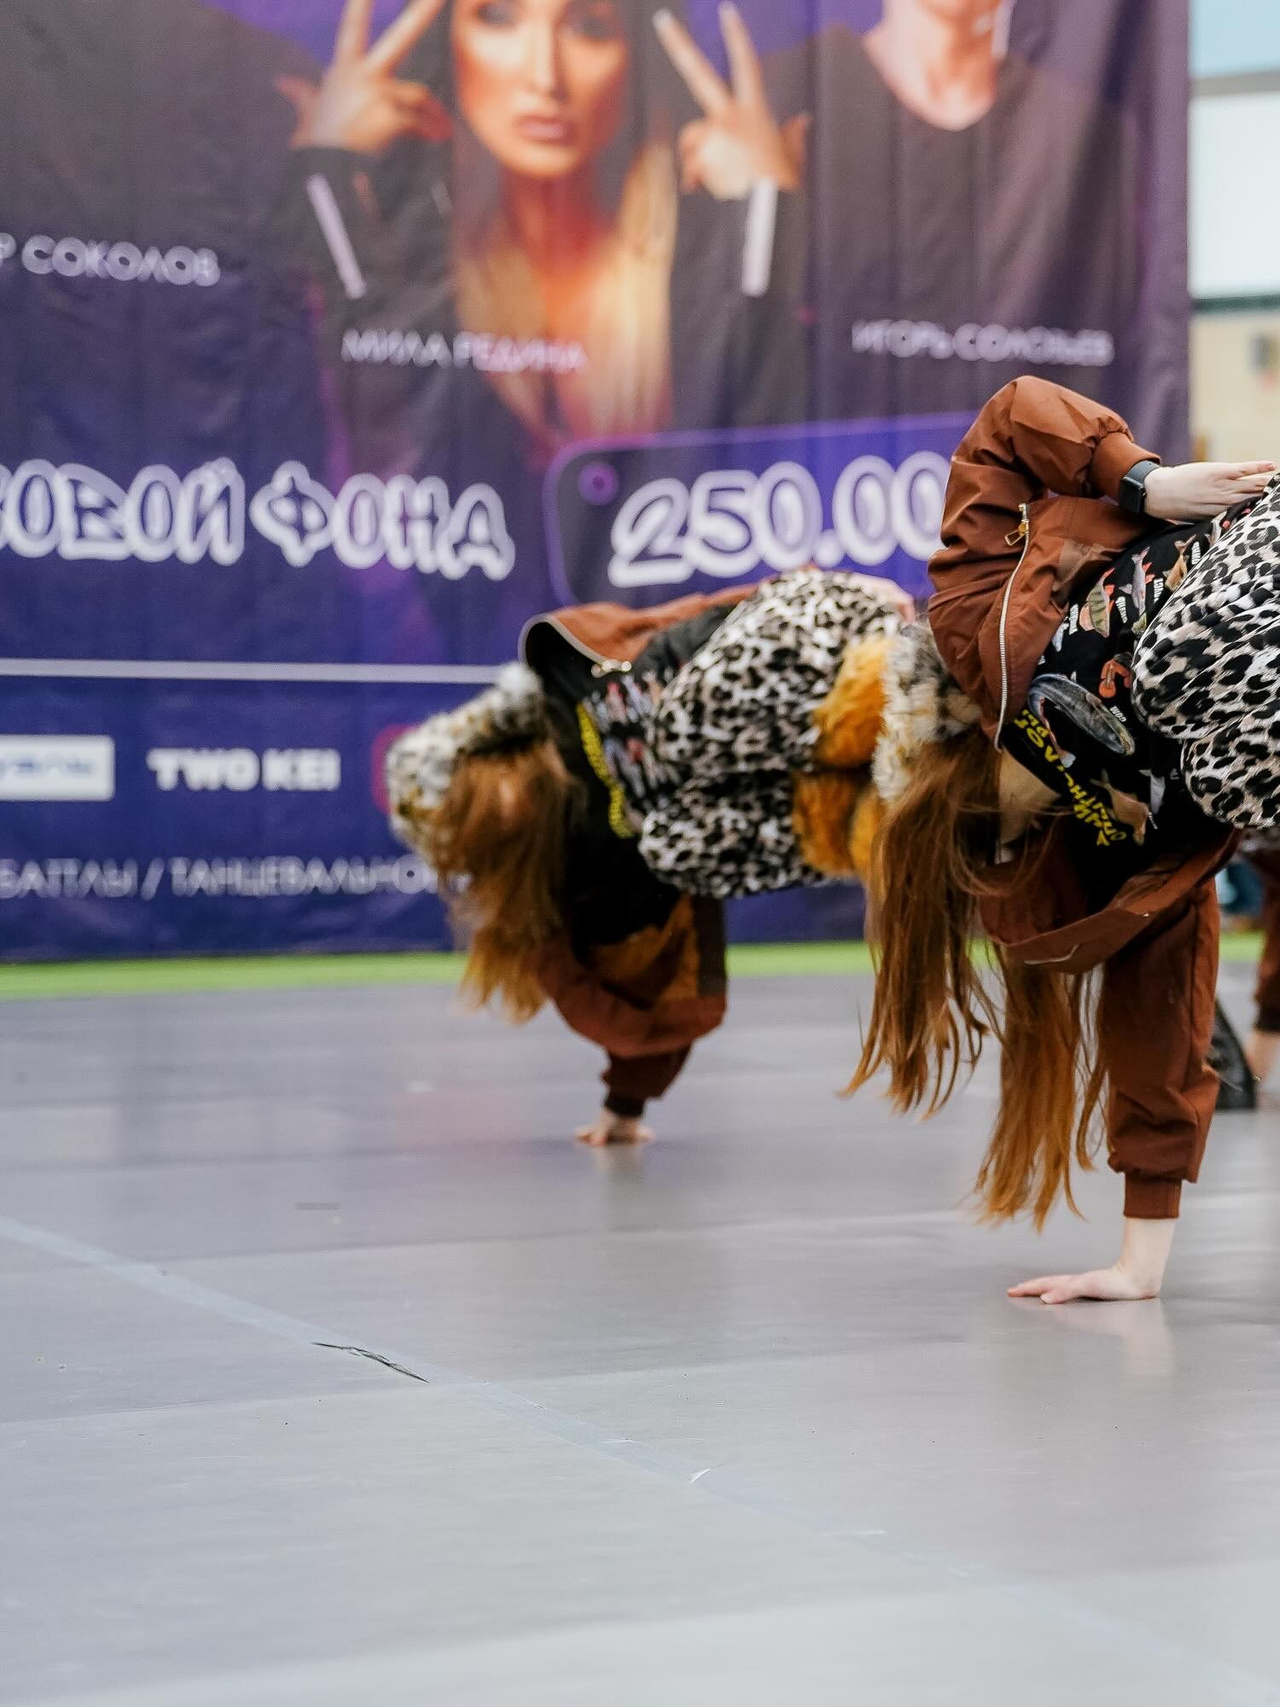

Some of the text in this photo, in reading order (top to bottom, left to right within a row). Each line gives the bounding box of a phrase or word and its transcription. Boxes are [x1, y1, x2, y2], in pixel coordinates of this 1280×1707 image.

[21, 234, 221, 287] СОКОЛОВ
[341, 328, 589, 374] МИЛА РЕДИНА
[852, 319, 953, 359] ИГОРЬ
[0, 457, 516, 581] ОВОЙ ФОНД
[1109, 705, 1127, 723] СОМ
[146, 748, 260, 792] TWO
